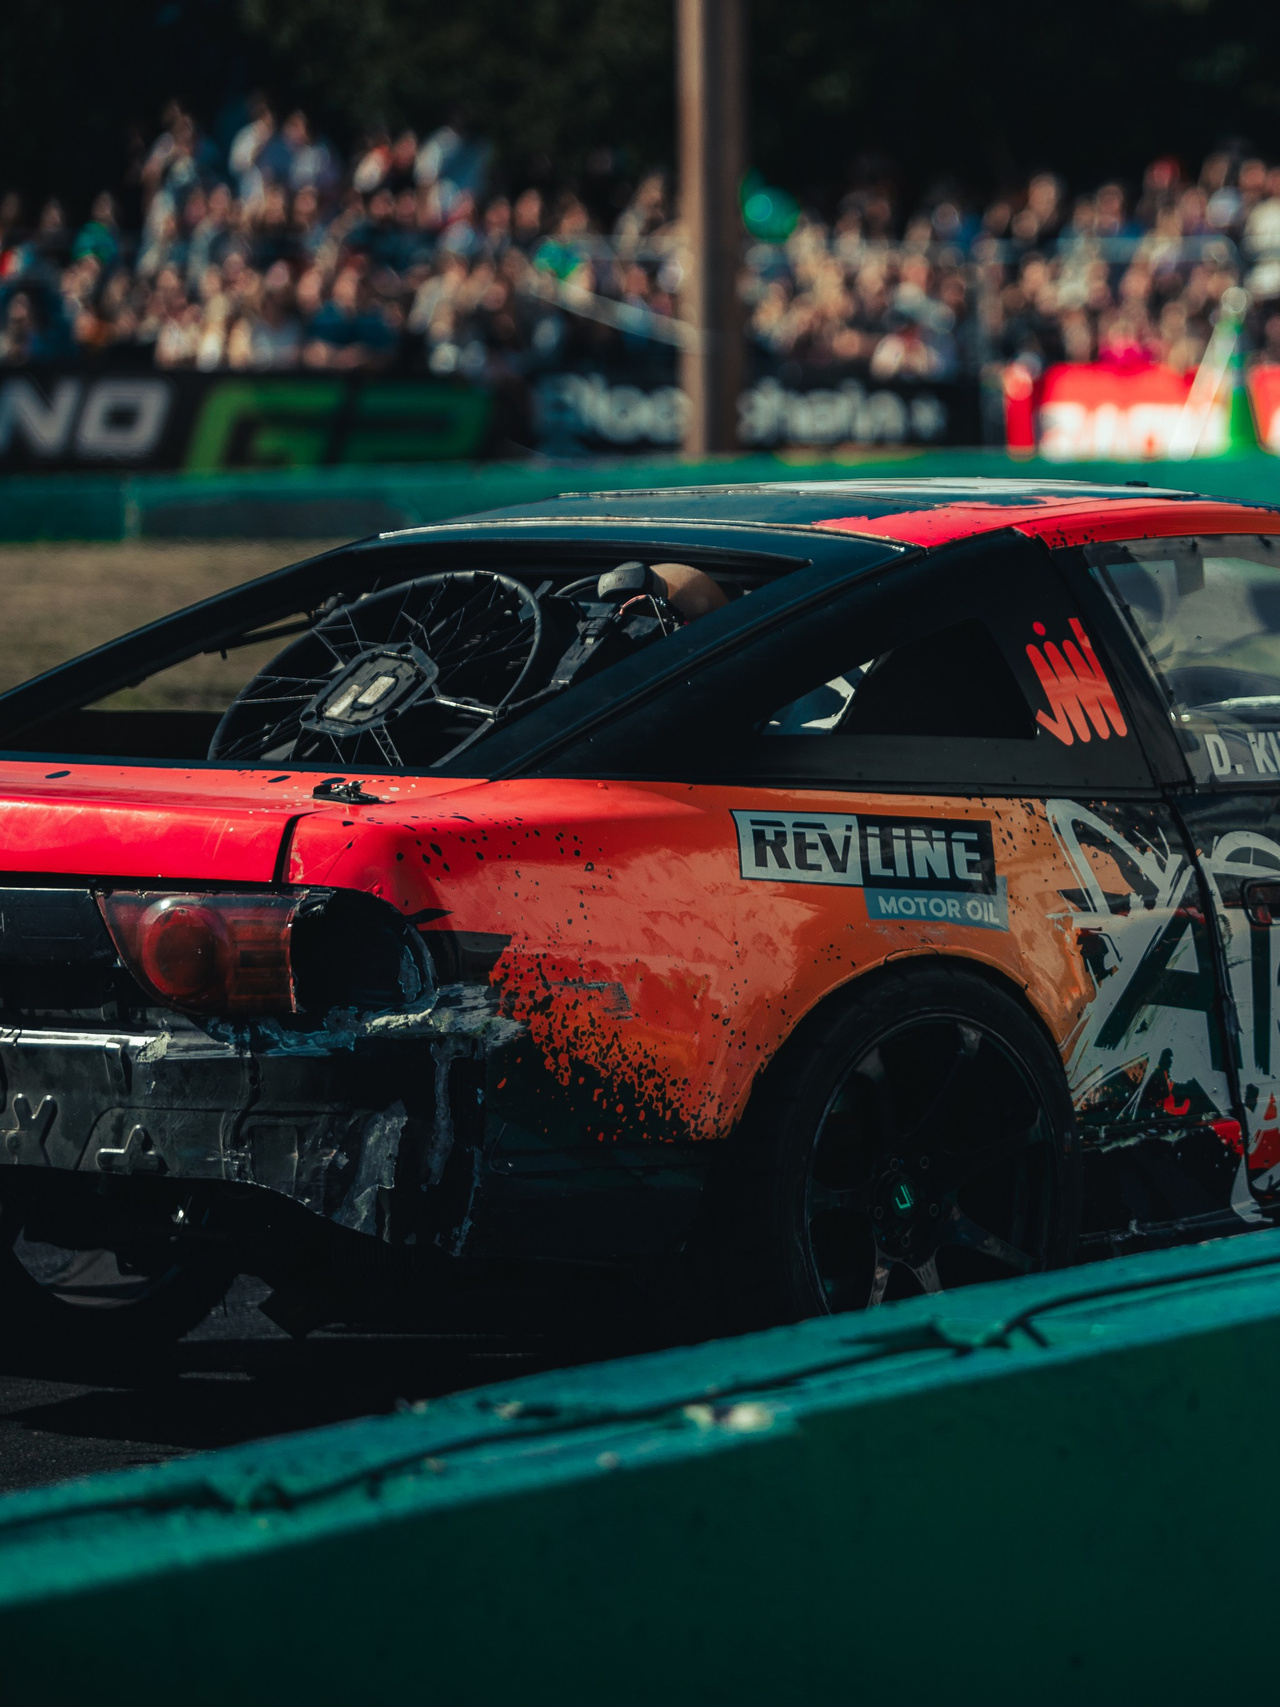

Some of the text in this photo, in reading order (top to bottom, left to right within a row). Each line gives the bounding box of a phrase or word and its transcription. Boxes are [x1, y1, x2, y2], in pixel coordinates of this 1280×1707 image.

[1203, 733, 1245, 775] D.
[877, 895, 1000, 924] MOTOR OIL
